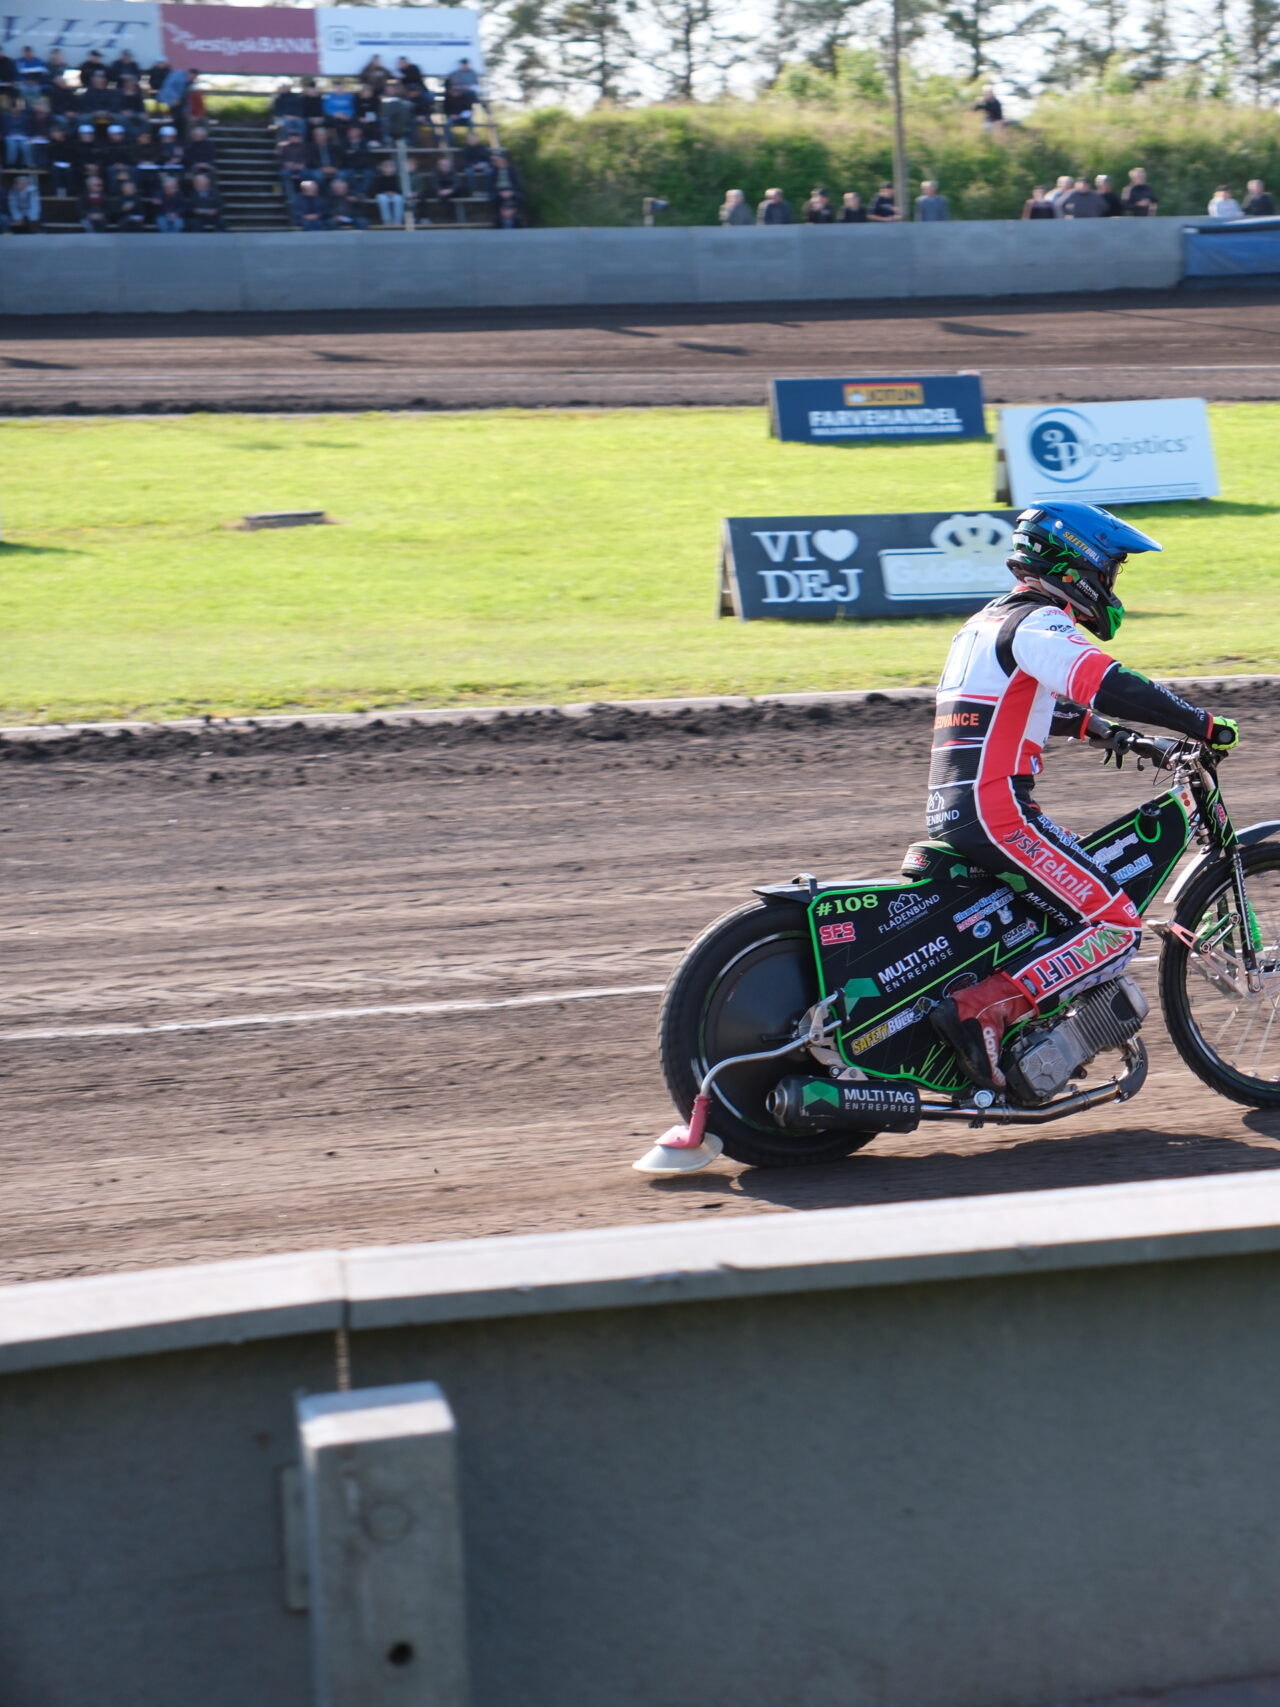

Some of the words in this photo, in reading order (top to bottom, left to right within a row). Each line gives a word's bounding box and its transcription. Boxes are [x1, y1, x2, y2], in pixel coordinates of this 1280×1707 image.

[808, 408, 963, 427] FARVEHANDEL
[750, 530, 817, 562] VI
[757, 568, 864, 603] DEJ
[1002, 829, 1094, 903] yskTeknik
[816, 894, 879, 917] #108
[878, 894, 940, 934] FLADENBUND
[819, 922, 856, 941] SFS
[877, 952, 921, 985] MULTI
[917, 936, 949, 960] TAG
[885, 948, 954, 993] ENTREPRISE
[844, 1088, 884, 1102] MULTI
[886, 1090, 915, 1104] TAG
[845, 1102, 916, 1113] ENTREPRISE
